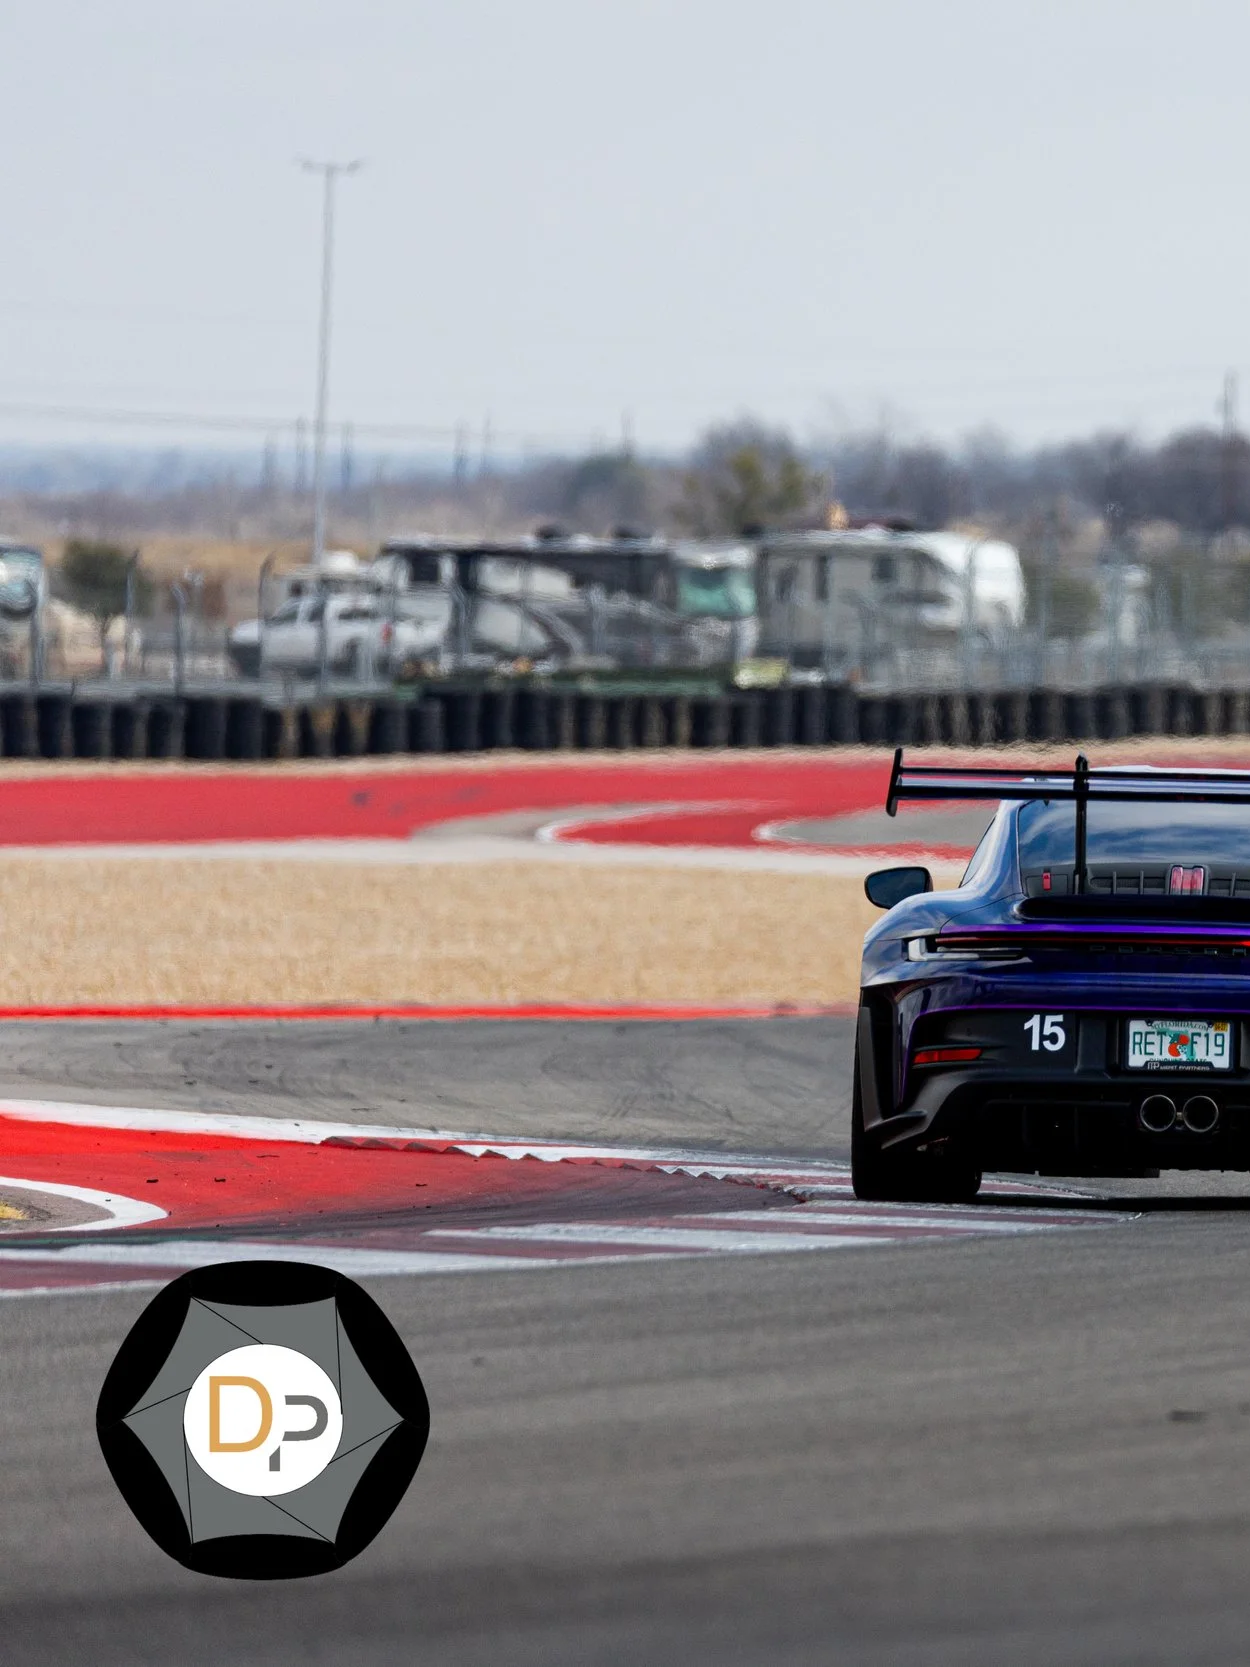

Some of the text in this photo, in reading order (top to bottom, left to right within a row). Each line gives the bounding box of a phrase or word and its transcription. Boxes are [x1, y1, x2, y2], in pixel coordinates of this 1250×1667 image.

[1023, 1014, 1066, 1051] 15
[1132, 1031, 1225, 1057] RET F19
